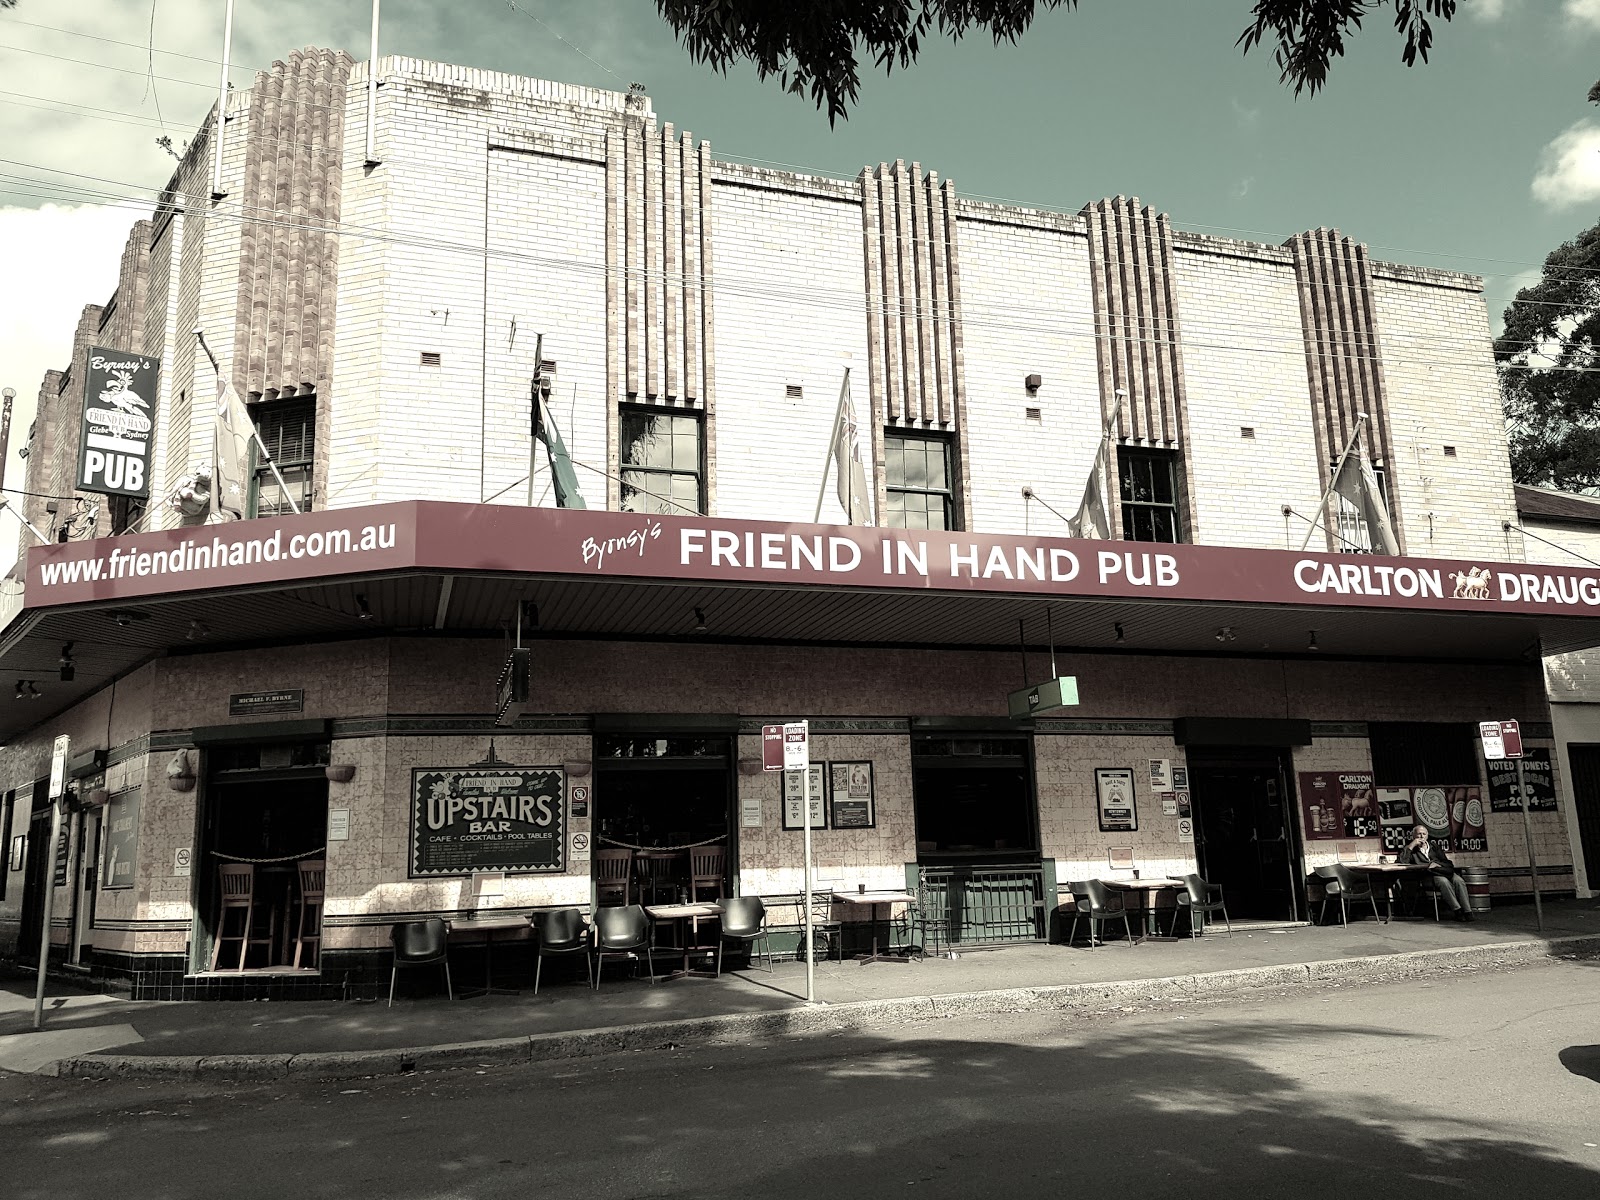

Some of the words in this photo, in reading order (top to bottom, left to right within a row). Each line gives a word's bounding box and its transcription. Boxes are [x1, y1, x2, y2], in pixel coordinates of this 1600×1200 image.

[91, 356, 150, 373] Byrnsy's
[89, 411, 118, 425] FRIEND
[118, 416, 126, 426] IN
[128, 418, 149, 430] HAND
[89, 425, 109, 434] Glebe
[126, 430, 149, 440] Sydney
[83, 449, 144, 491] PUB
[40, 523, 396, 586] www.friendinhand.com.au
[679, 528, 862, 573] FRIEND
[882, 539, 929, 576] IN
[949, 543, 1080, 582] HAND
[1098, 551, 1180, 587] PUB
[1293, 559, 1445, 599] CARLTON
[1496, 572, 1600, 605] DRAUG
[785, 727, 805, 735] LOADING
[1488, 761, 1514, 771] VOTED
[465, 779, 487, 787] FRIEND
[1338, 775, 1372, 783] CARLTON
[1492, 772, 1517, 787] BEST
[1523, 772, 1550, 788] OCAL
[427, 795, 553, 830] UPSTAIRS
[469, 820, 512, 834] BAR
[460, 834, 503, 842] COCKTAILS
